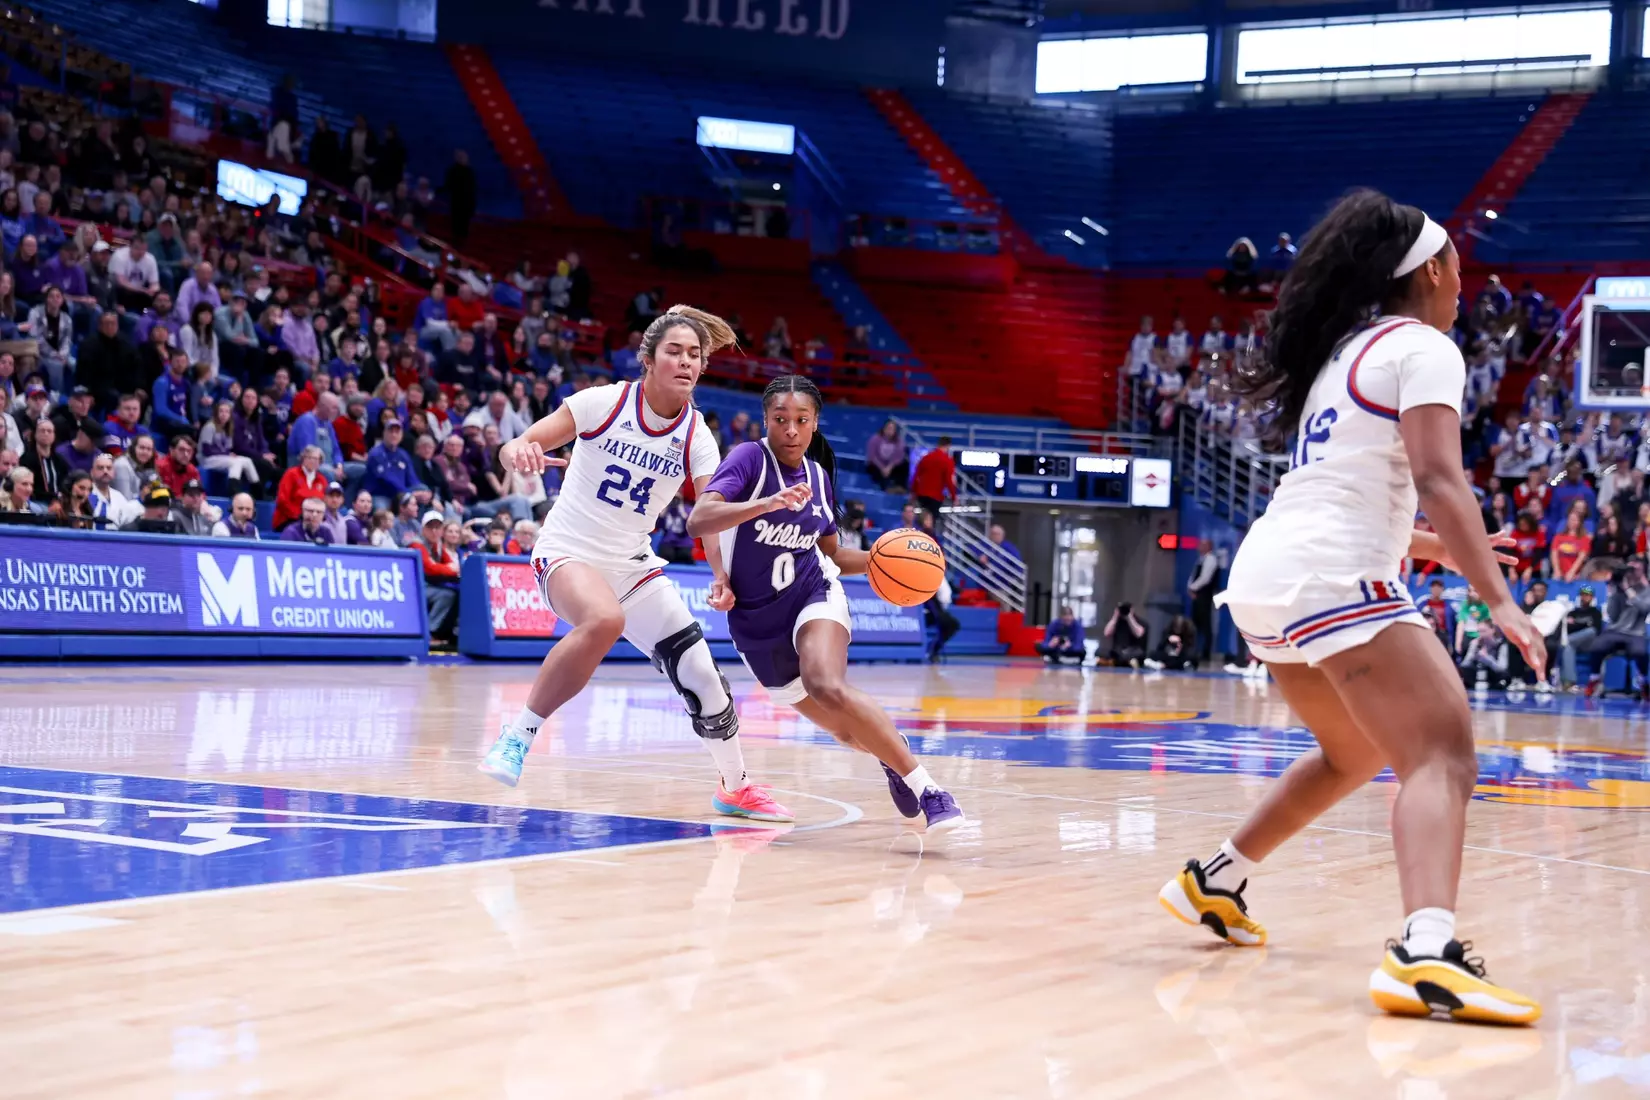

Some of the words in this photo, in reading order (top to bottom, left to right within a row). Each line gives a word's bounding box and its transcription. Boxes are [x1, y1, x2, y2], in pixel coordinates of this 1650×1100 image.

[599, 438, 682, 478] JAYHAWKS
[596, 463, 656, 516] 24
[907, 540, 941, 558] NCAA
[5, 558, 120, 588] UNIVERSITY
[122, 566, 147, 589] OF
[266, 555, 405, 602] Meritrust
[771, 551, 795, 592] 0
[43, 586, 116, 614] HEALTH
[119, 588, 184, 615] SYSTEM
[271, 606, 330, 628] CREDIT
[334, 608, 387, 629] UNION
